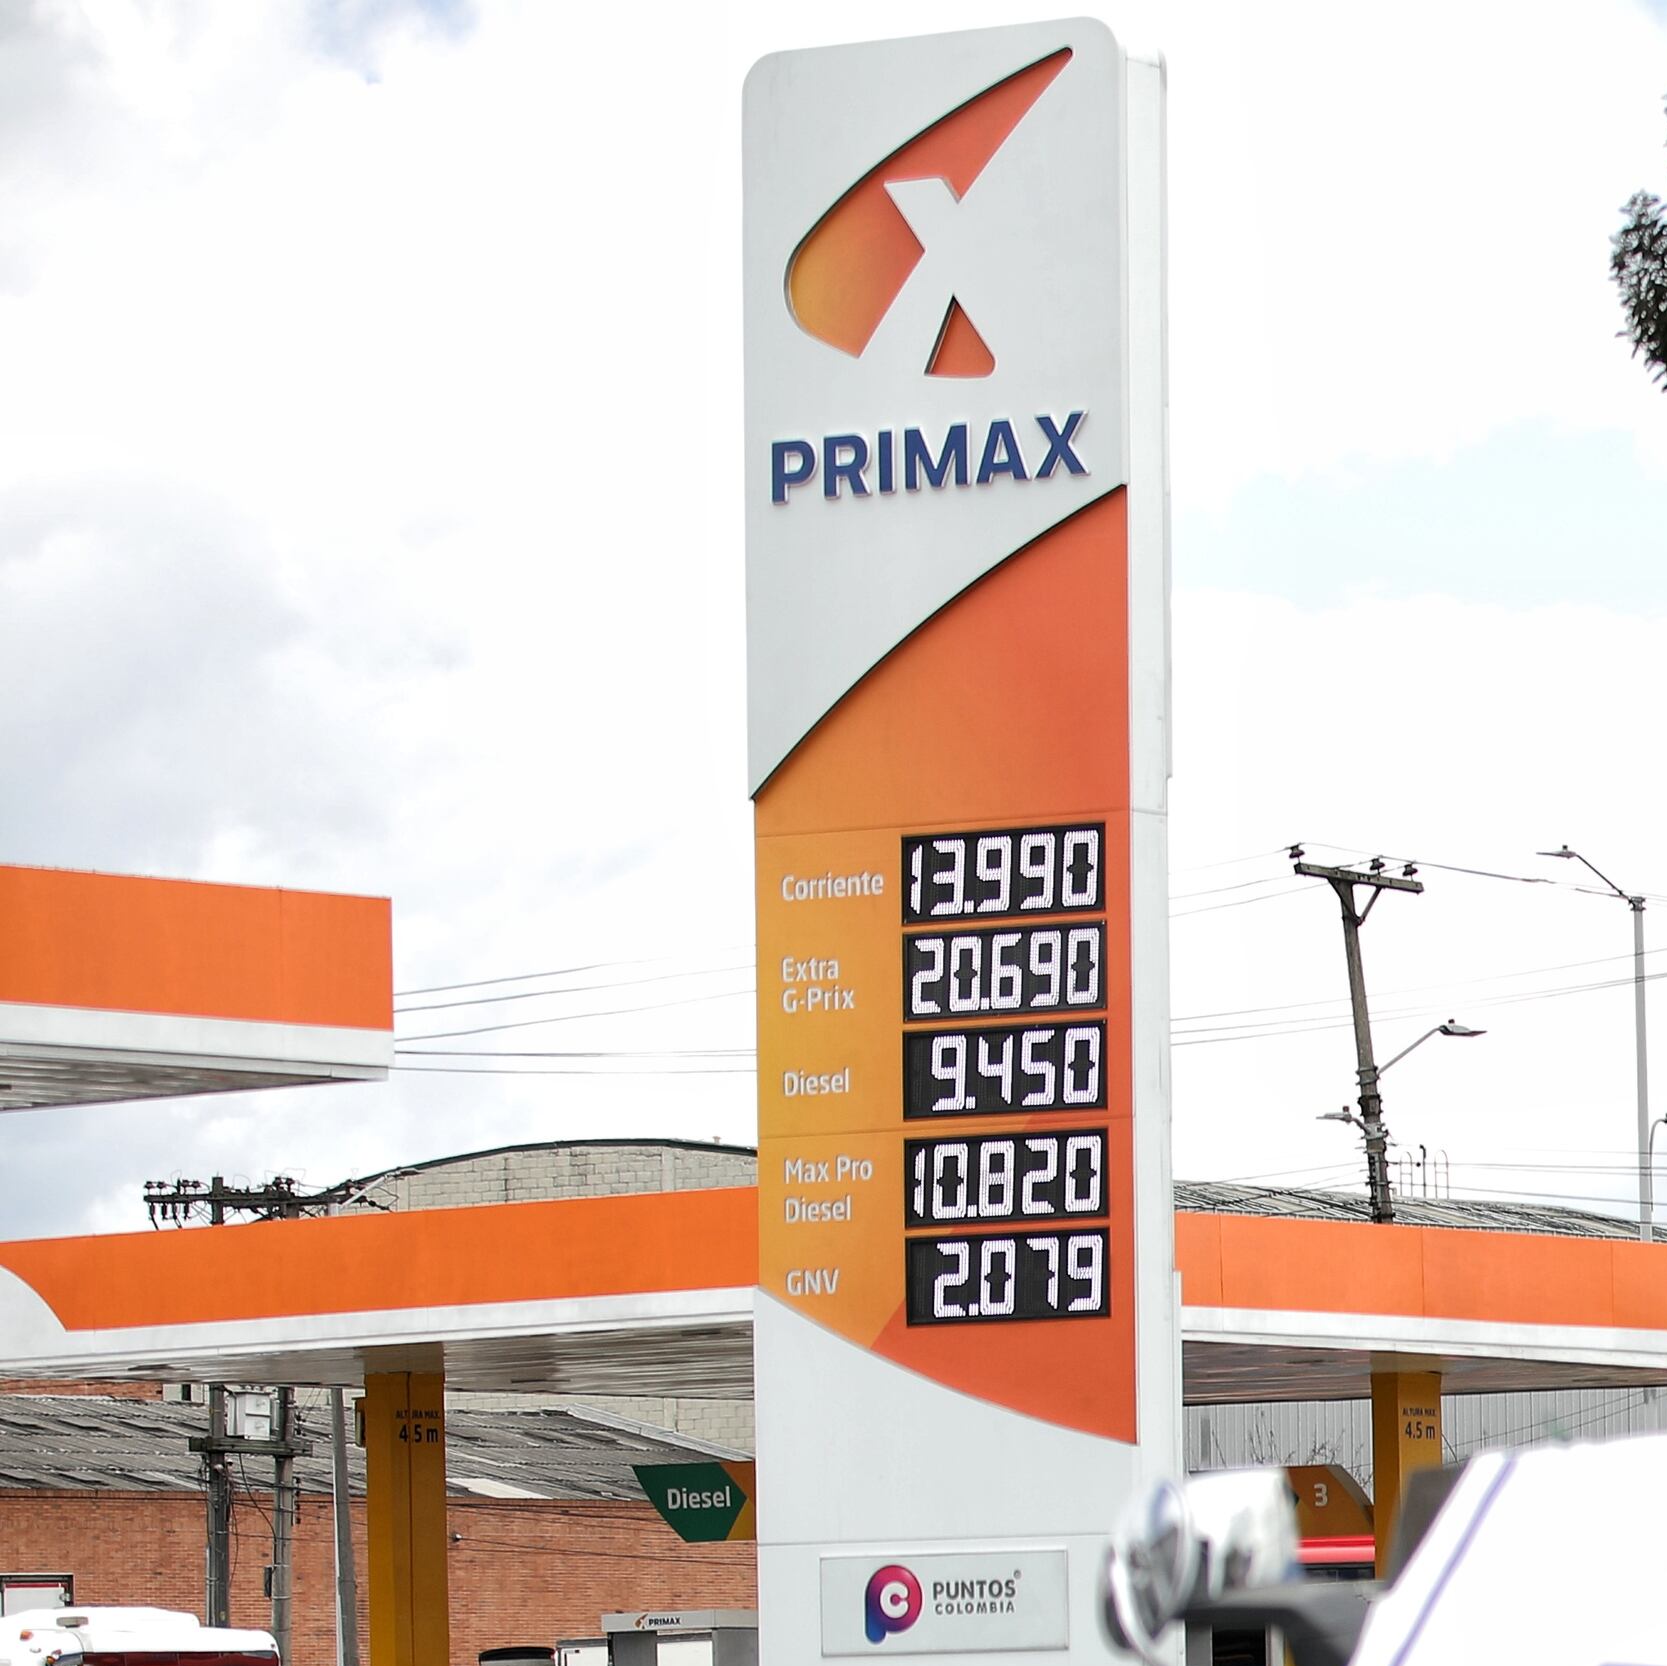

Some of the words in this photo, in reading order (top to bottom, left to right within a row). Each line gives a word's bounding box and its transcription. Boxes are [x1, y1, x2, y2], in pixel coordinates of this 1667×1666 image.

[771, 409, 1090, 504] PRIMAX
[910, 828, 1100, 916] 13.990
[782, 871, 884, 902] Corriente
[782, 957, 839, 983] Extra
[910, 927, 1100, 1015] 20.690
[783, 987, 854, 1013] G-Prix
[783, 1066, 850, 1097] Diesel
[931, 1026, 1101, 1112] 9.450
[784, 1159, 829, 1184] Max
[836, 1156, 873, 1181] Pro
[913, 1135, 1102, 1220] 10.820
[785, 1195, 852, 1224] Diesel
[787, 1269, 840, 1296] GNV
[932, 1234, 1103, 1319] 2.079
[667, 1486, 731, 1510] Diesel
[1314, 1483, 1328, 1507] 3
[932, 1578, 1016, 1600] PUNTOS
[648, 1617, 681, 1626] PRIMAX
[935, 1601, 1015, 1615] COLOMBIA
